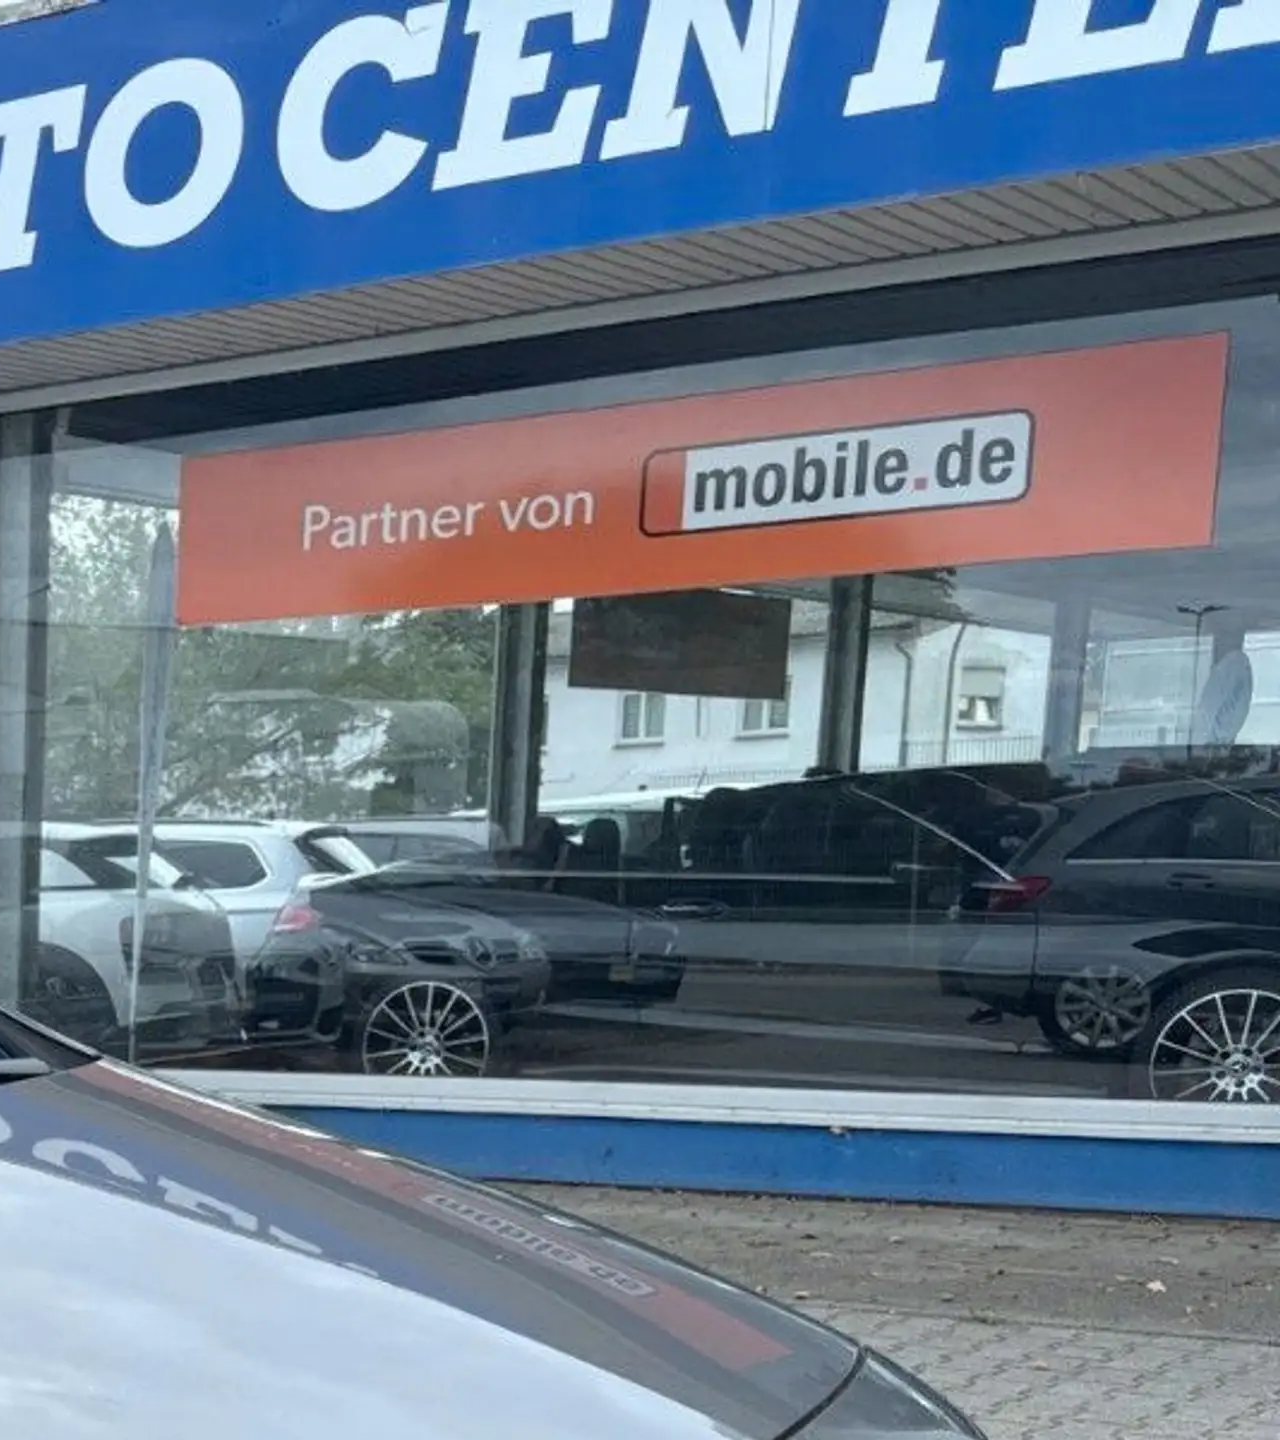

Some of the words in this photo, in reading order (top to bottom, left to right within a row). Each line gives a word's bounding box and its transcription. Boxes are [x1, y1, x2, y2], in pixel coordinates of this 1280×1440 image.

[277, 0, 1280, 212] CEN
[302, 500, 484, 550] Partner
[500, 490, 593, 532] von
[693, 428, 1016, 513] mobile.de
